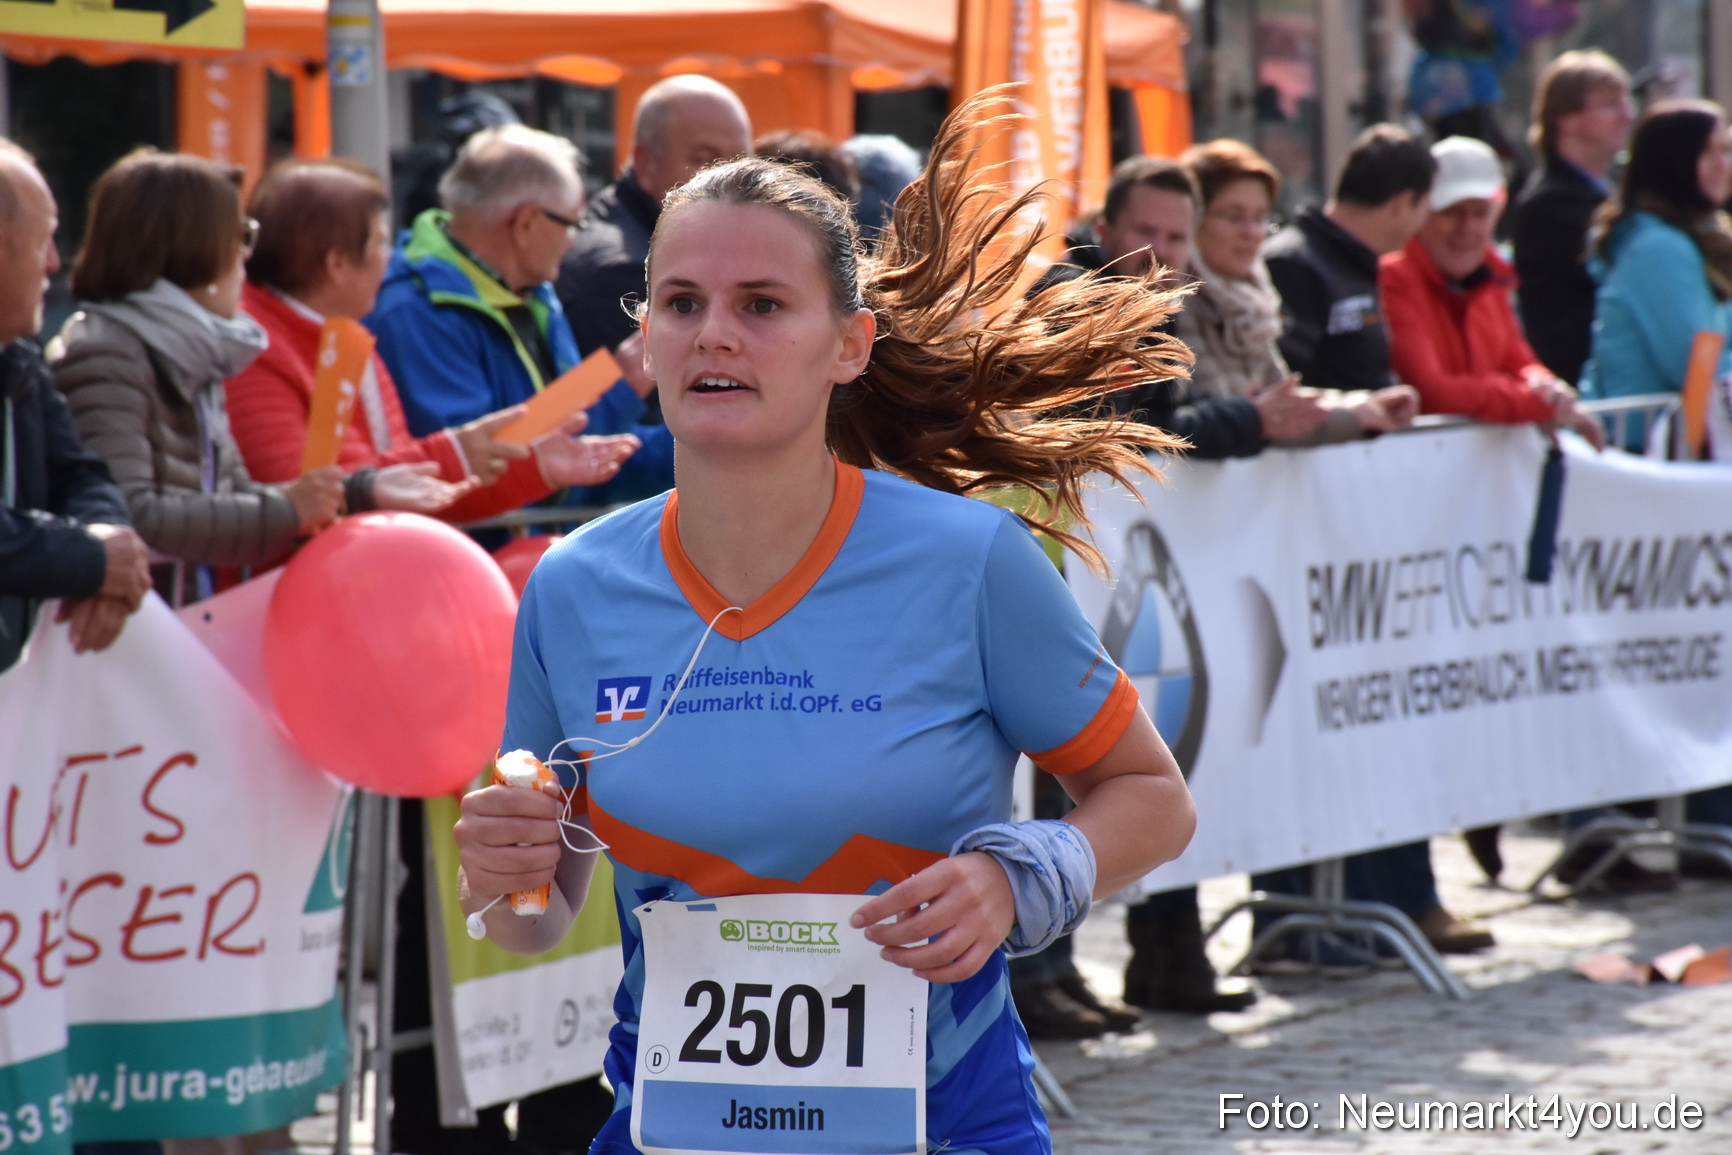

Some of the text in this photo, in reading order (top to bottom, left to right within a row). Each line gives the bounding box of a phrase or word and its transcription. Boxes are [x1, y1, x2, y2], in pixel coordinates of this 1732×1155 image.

[662, 665, 815, 692] Raiffeisenbank
[659, 690, 764, 716] Neumarkt
[850, 694, 882, 713] eG
[746, 919, 840, 944] BOCK
[747, 944, 775, 952] inspired
[776, 945, 785, 953] by
[806, 946, 841, 955] concepts
[678, 980, 866, 1068] 2501
[721, 1098, 825, 1131] Jasmin
